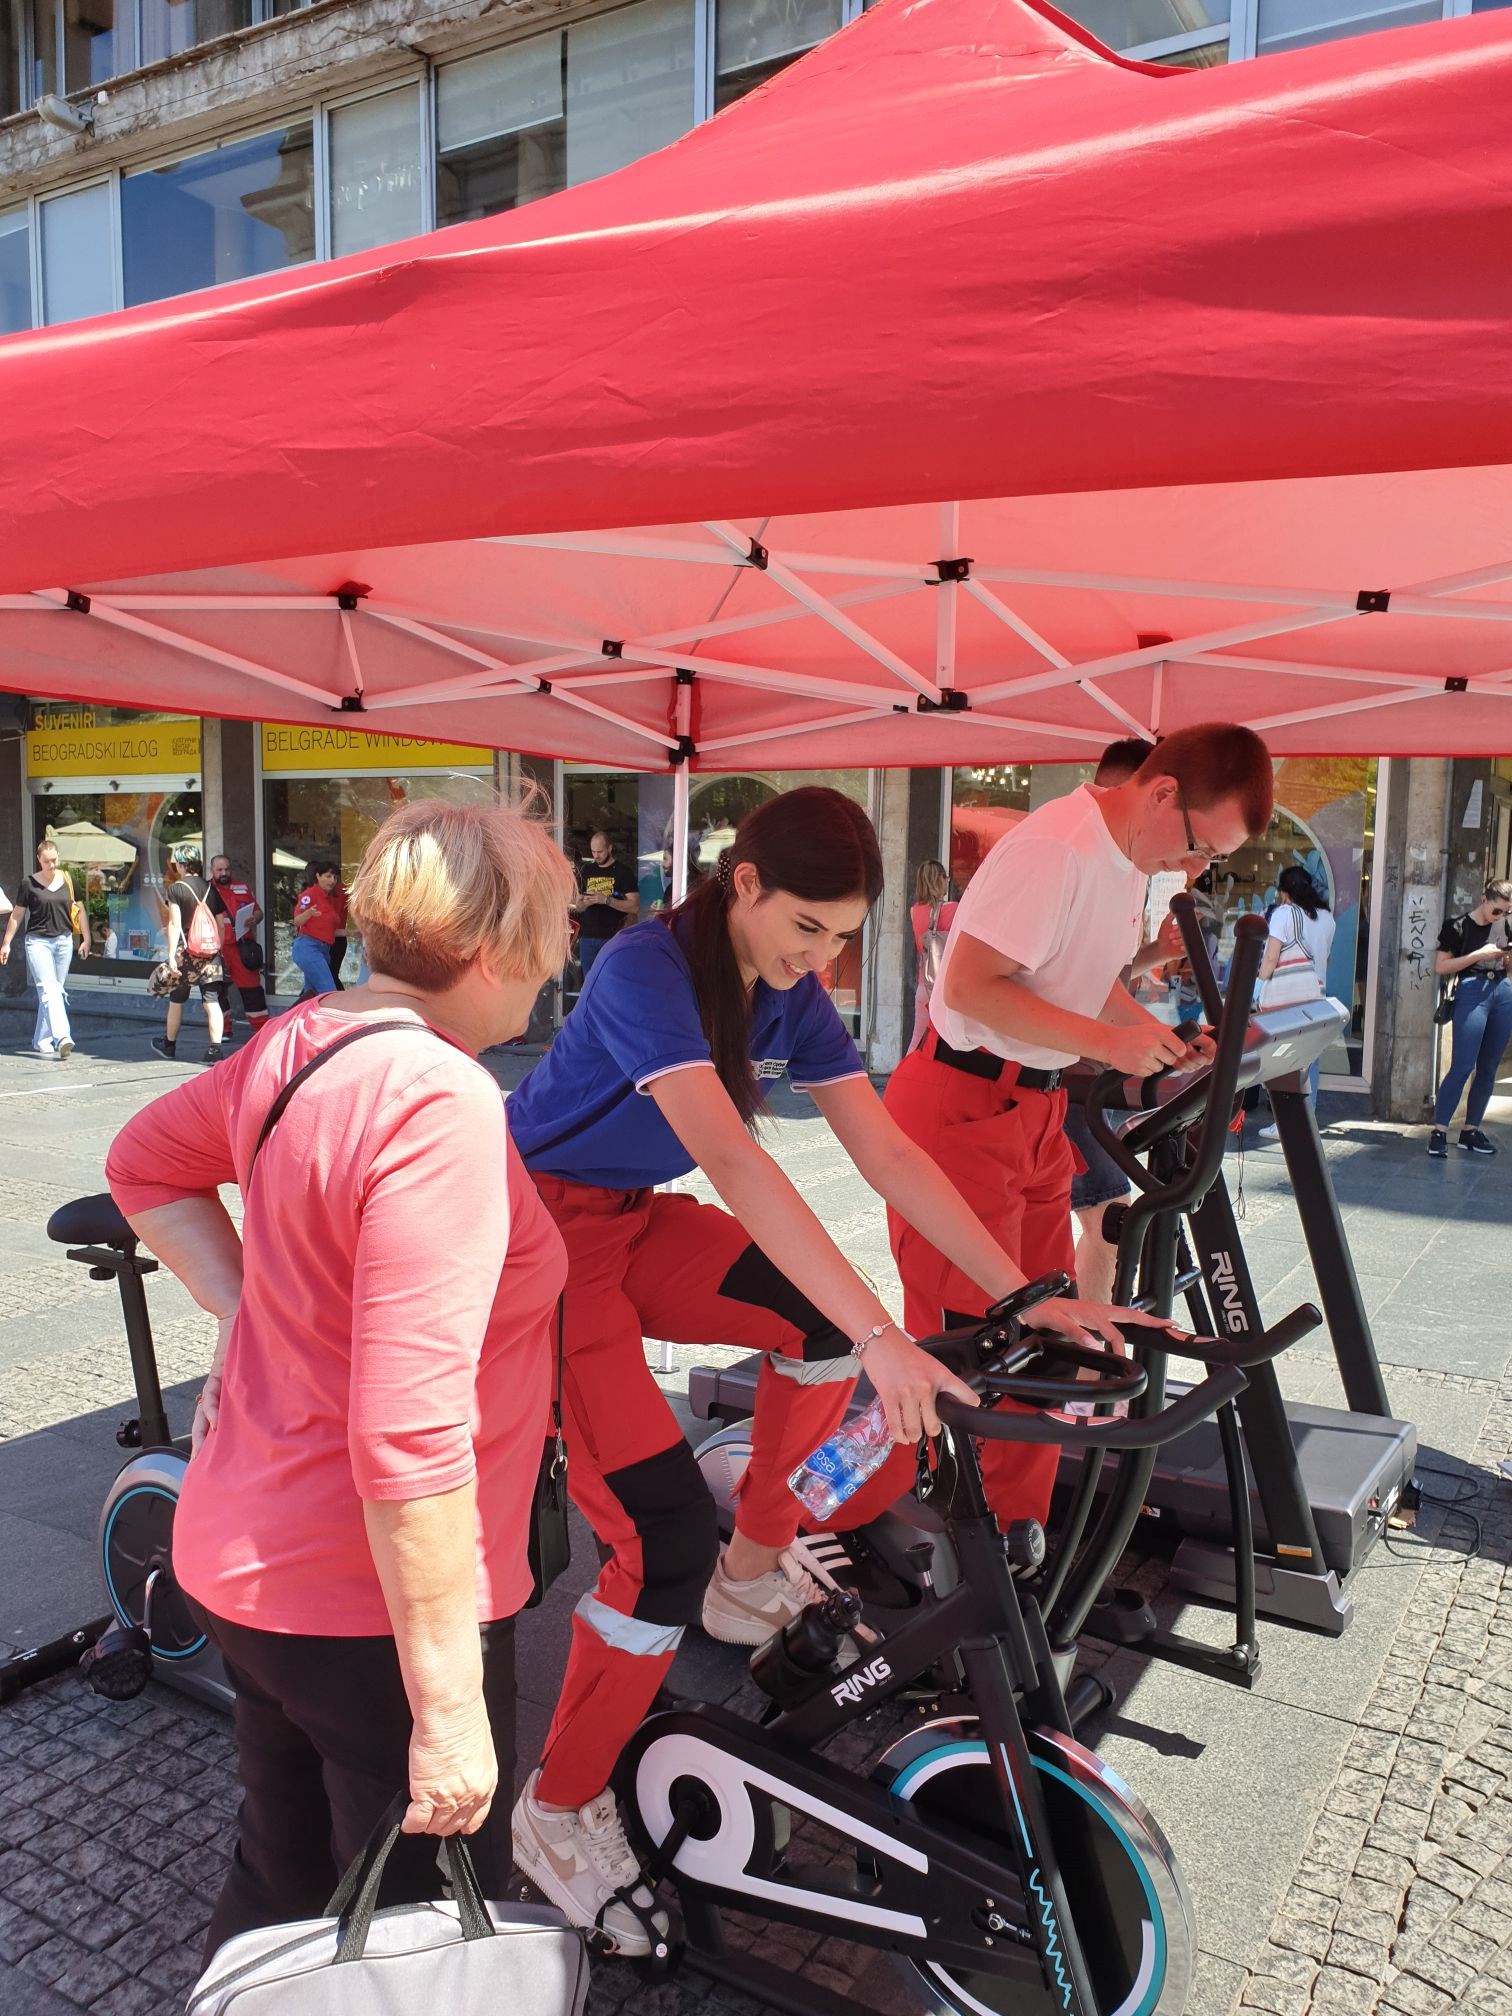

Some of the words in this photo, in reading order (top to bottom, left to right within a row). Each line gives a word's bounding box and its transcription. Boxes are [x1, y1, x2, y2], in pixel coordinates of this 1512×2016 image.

[35, 712, 96, 731] SUVENIRI
[32, 742, 116, 762] BEOGRADSKI
[119, 739, 158, 759] IZLOG
[266, 730, 359, 752] BELGRADE
[1210, 1251, 1249, 1333] RING
[830, 1655, 892, 1707] RING
